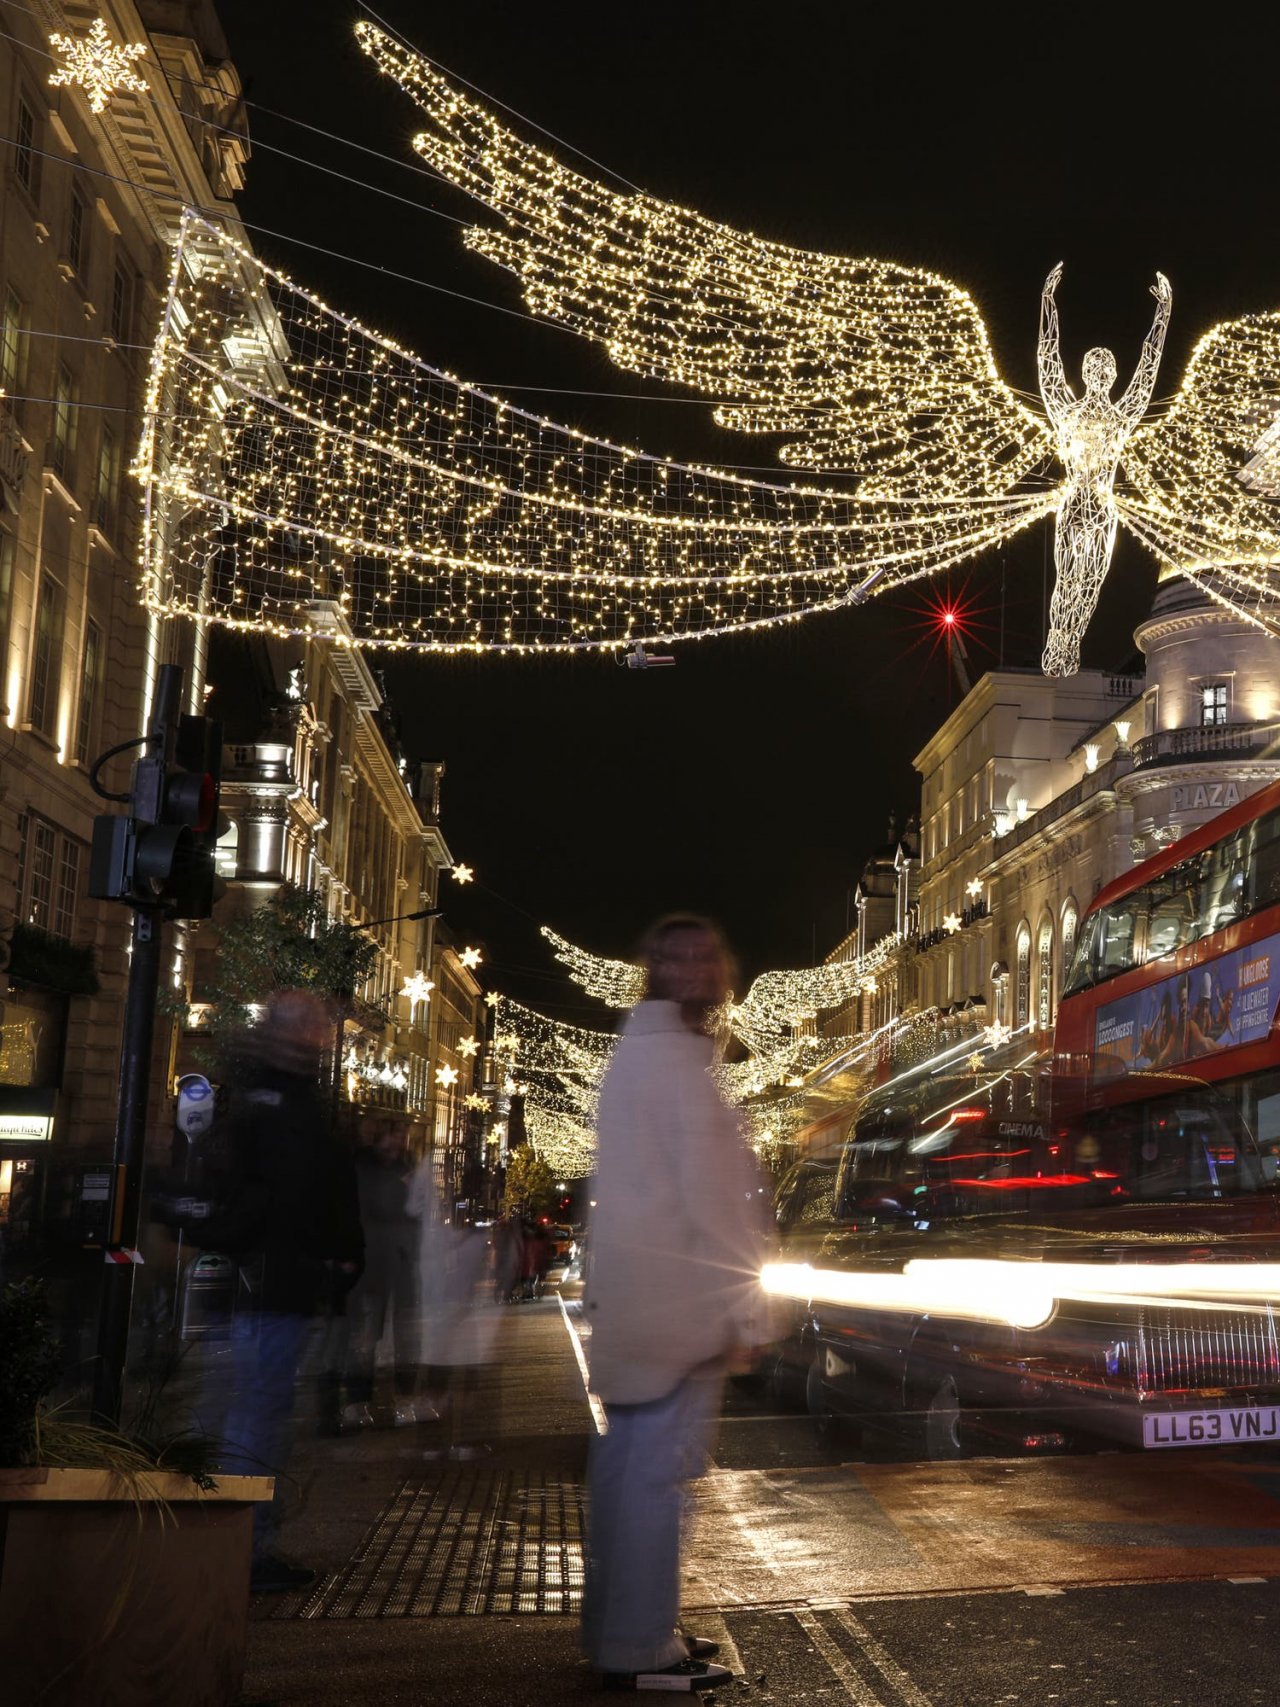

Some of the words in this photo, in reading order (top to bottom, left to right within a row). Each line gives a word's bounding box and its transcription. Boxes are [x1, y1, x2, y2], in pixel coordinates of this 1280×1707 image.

[1169, 782, 1241, 811] PLAZA
[998, 1121, 1044, 1138] CINEMA
[1153, 1413, 1222, 1443] LL63
[1229, 1410, 1277, 1438] VNJ
